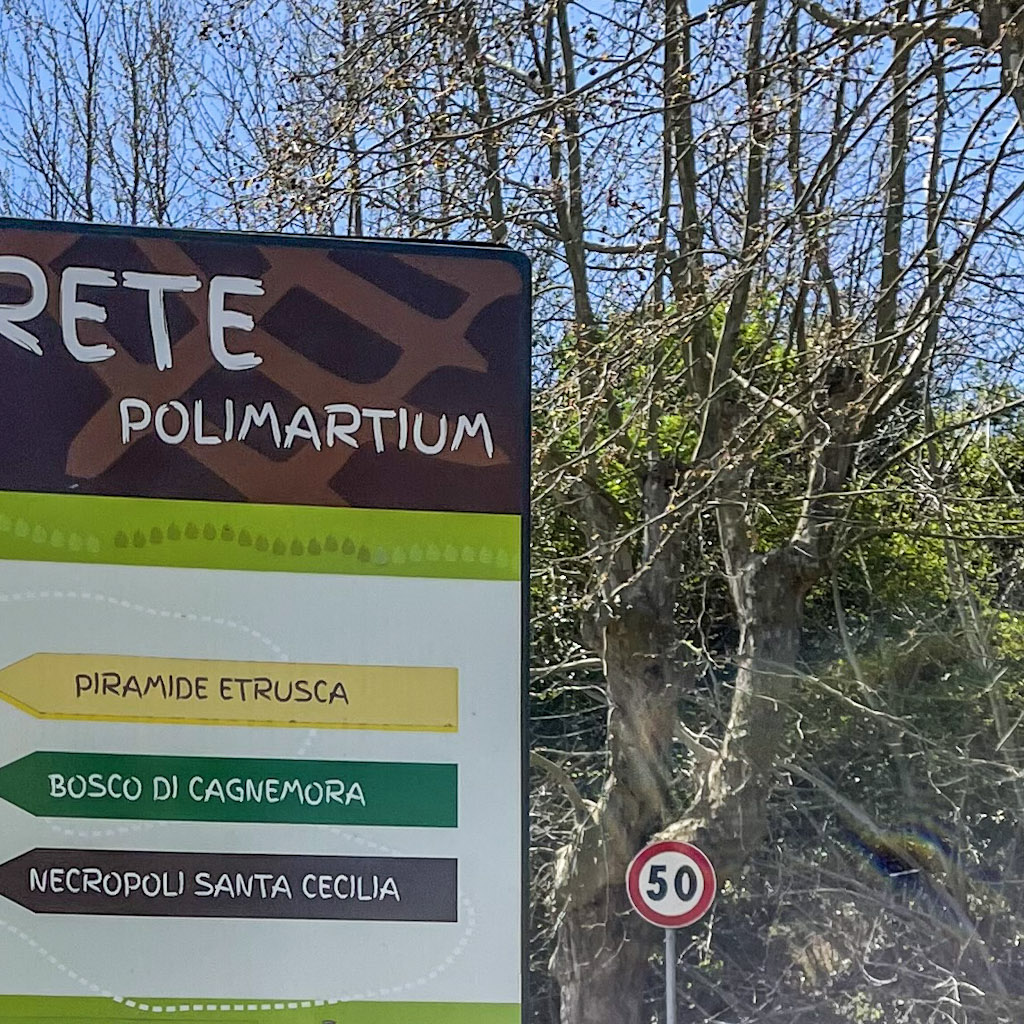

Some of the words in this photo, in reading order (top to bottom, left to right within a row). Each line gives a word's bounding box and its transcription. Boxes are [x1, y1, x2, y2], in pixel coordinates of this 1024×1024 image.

[120, 398, 494, 459] POLIMARTIUM
[75, 672, 208, 700] PIRAMIDE
[219, 677, 349, 705] ETRUSCA
[48, 773, 142, 801] BOSCO
[153, 774, 178, 801] DI
[188, 776, 366, 807] CAGNEMORA
[29, 867, 184, 897] NECROPOLI
[194, 873, 293, 900] SANTA
[302, 873, 401, 902] CECILIA
[646, 864, 698, 902] 50
